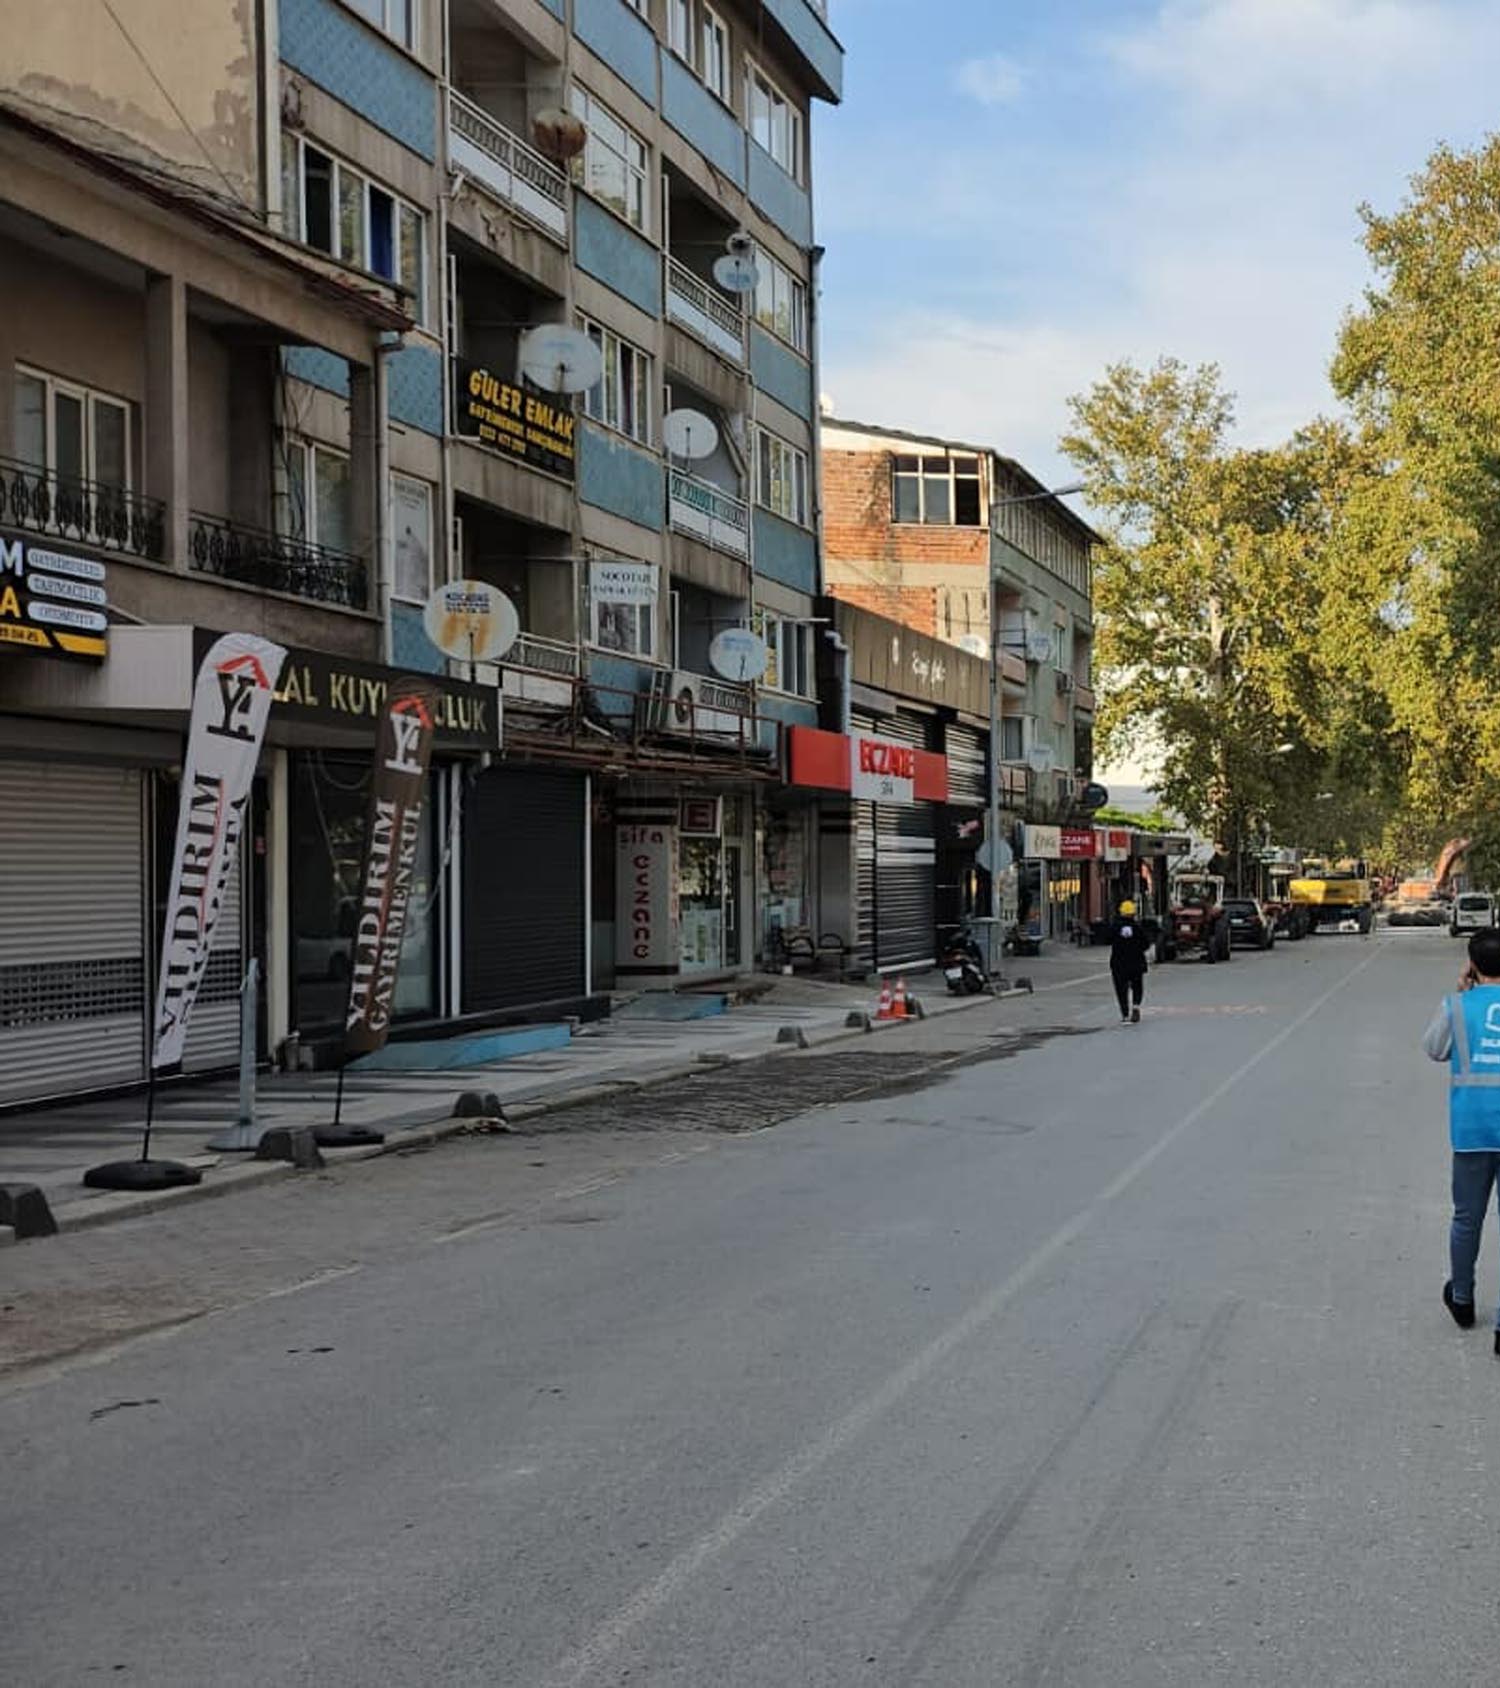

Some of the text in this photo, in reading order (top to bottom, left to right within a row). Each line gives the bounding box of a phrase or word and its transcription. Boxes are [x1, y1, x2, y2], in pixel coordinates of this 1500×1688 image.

[470, 368, 522, 417] GÜLER
[525, 398, 574, 440] EMLAK
[859, 738, 915, 779] ECZANE
[346, 801, 396, 1032] YILDIRIM
[368, 801, 422, 1031] GAYRİMENKUL
